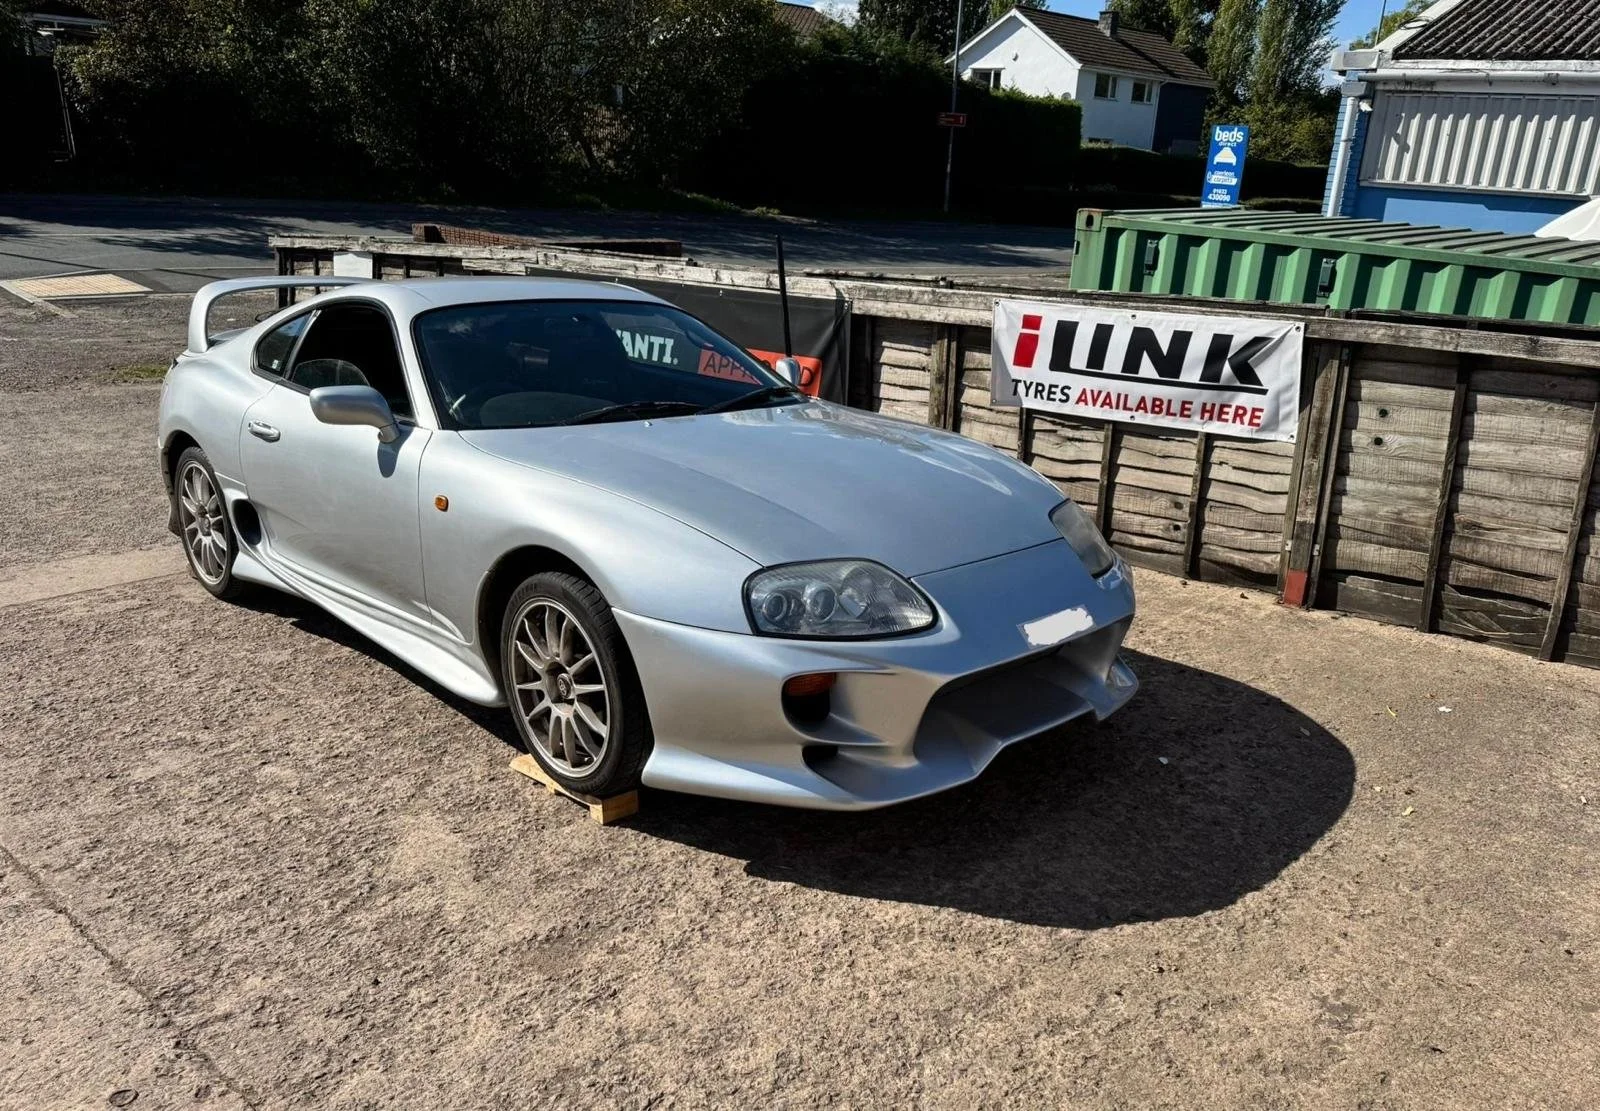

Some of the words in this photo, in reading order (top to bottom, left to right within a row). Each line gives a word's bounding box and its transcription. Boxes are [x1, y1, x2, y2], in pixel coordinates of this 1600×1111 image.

[1215, 126, 1244, 142] beds
[1011, 378, 1072, 403] TYRES
[1075, 387, 1194, 418] AVAILABLE
[1200, 402, 1265, 428] HERE
